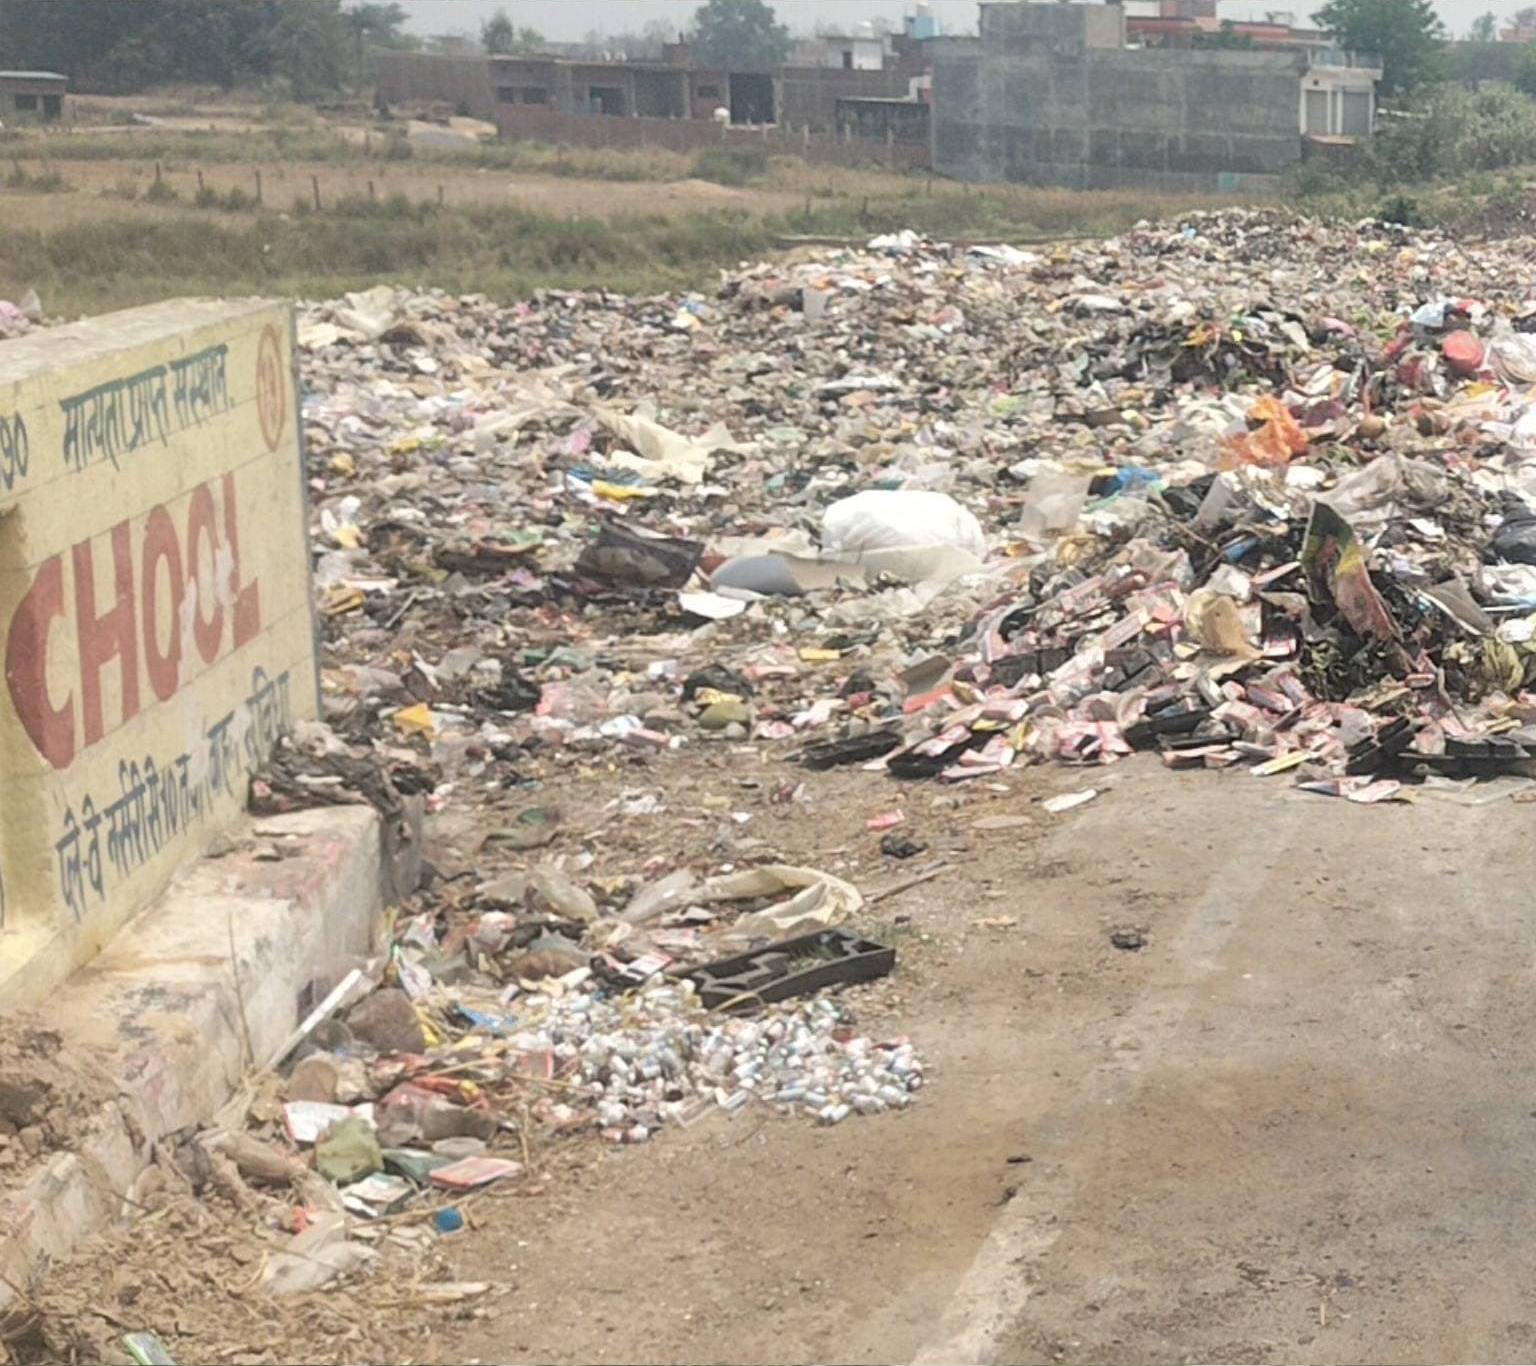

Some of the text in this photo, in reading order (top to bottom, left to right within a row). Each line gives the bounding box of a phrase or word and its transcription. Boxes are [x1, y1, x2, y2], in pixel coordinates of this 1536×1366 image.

[59, 377, 125, 473] मान्यता
[125, 363, 171, 453] प्राप्त
[5, 473, 262, 770] CHOOL
